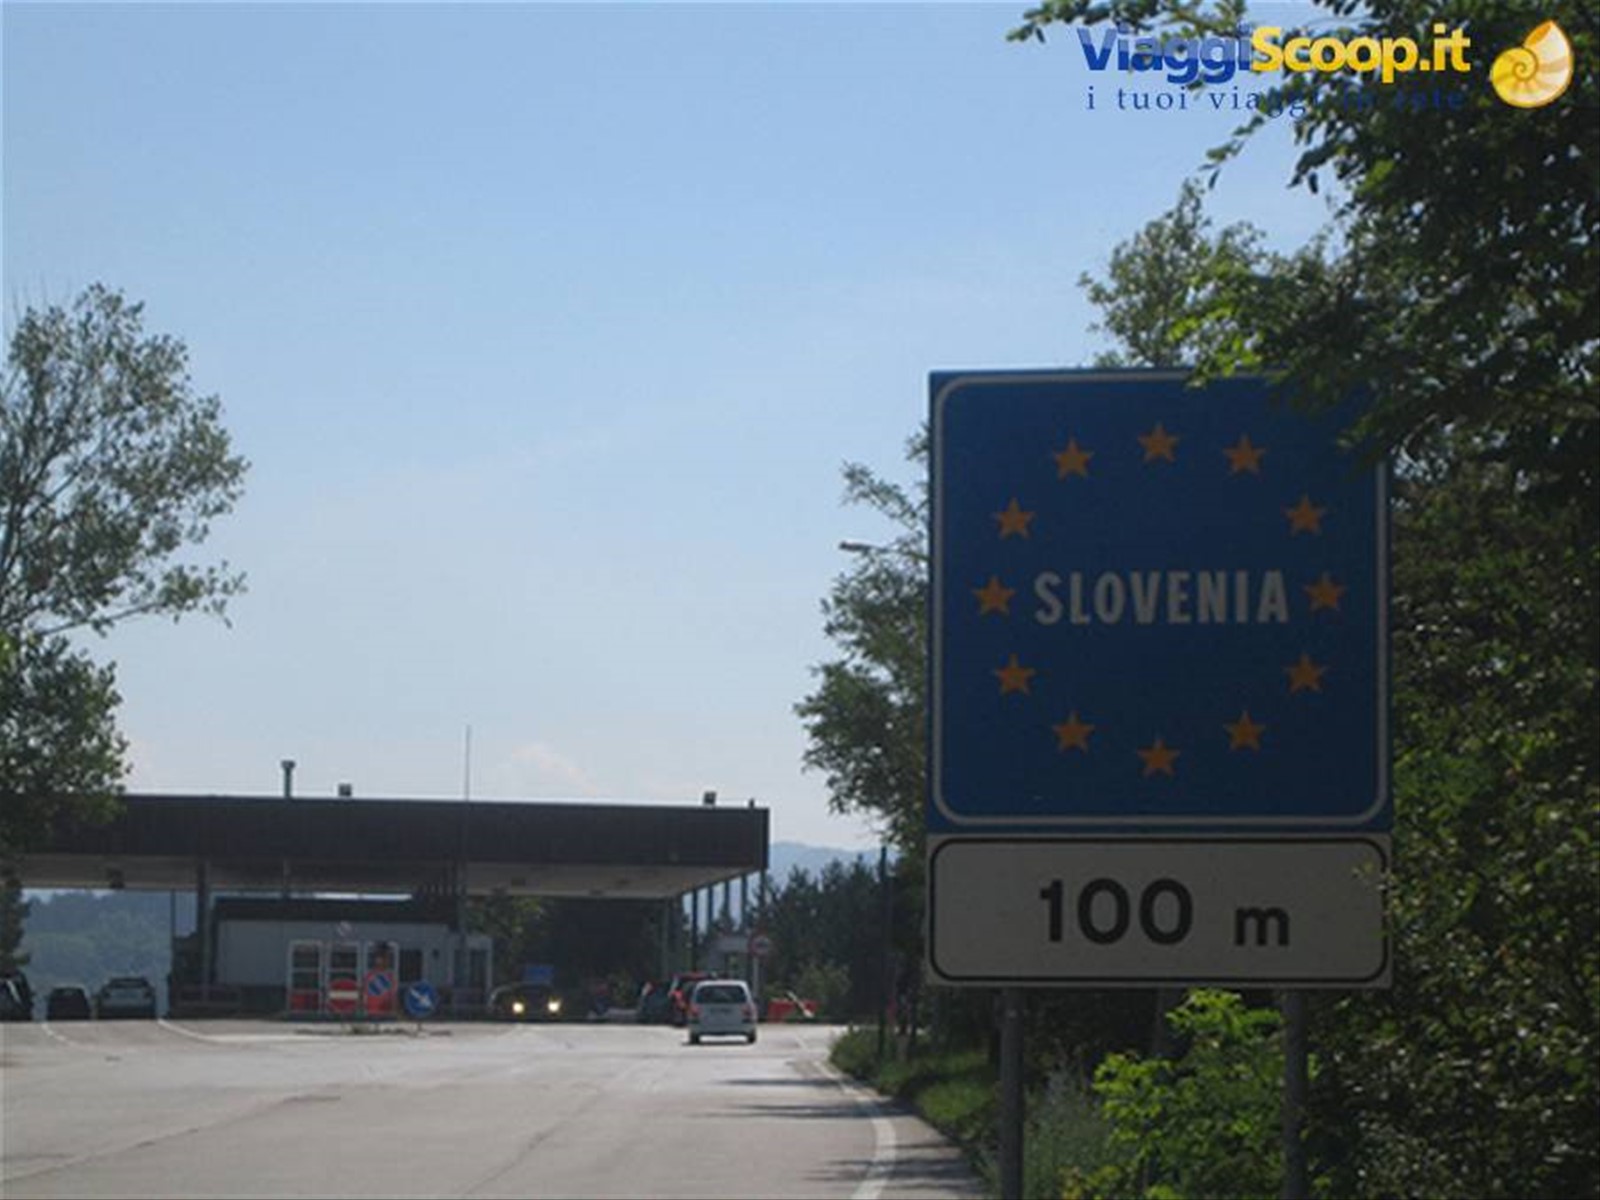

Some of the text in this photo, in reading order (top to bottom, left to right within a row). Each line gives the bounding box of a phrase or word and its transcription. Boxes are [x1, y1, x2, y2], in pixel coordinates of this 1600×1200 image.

[1034, 570, 1291, 625] SLOVENIA
[1039, 878, 1290, 946] 100 m
